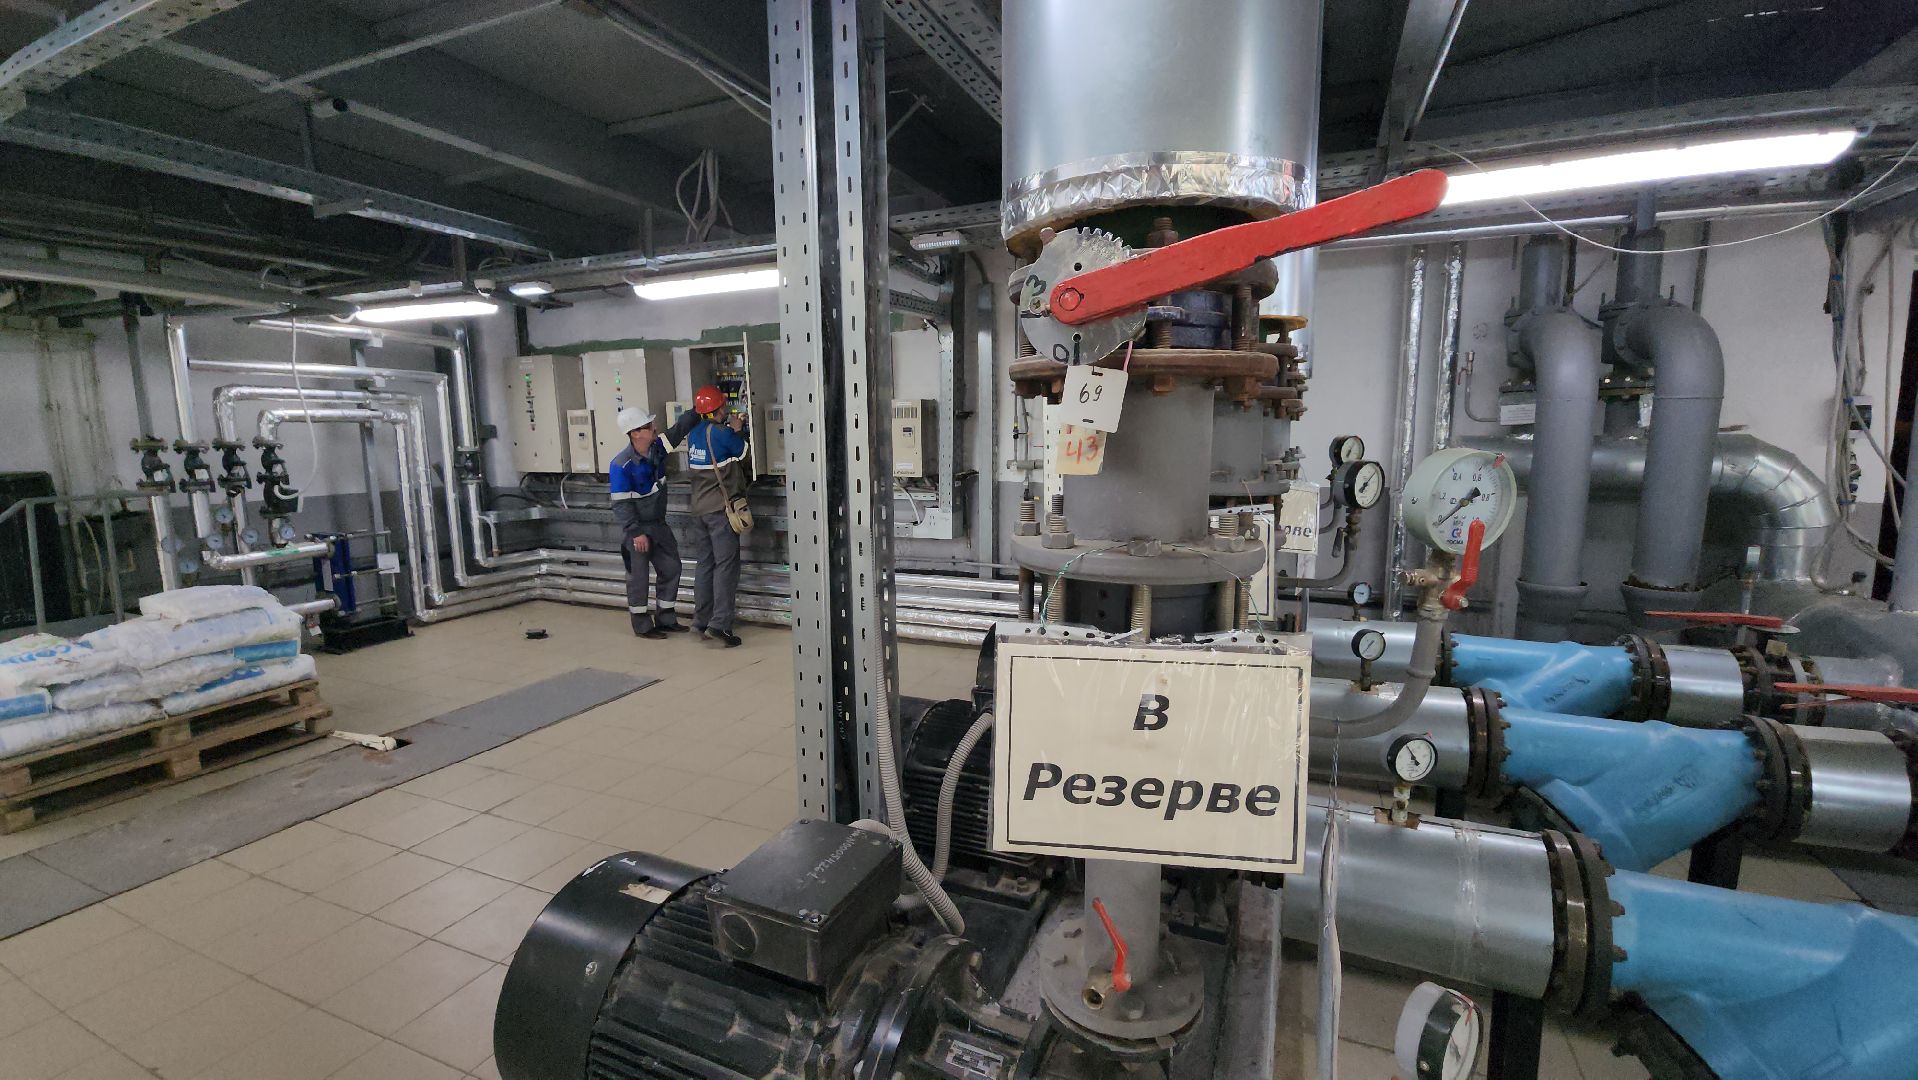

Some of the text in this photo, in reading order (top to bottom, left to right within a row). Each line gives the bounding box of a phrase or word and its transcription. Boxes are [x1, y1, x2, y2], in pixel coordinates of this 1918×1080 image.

[1079, 382, 1103, 404] 69
[1066, 435, 1099, 465] 43
[1132, 693, 1170, 731] В
[1022, 762, 1281, 821] Резерве
